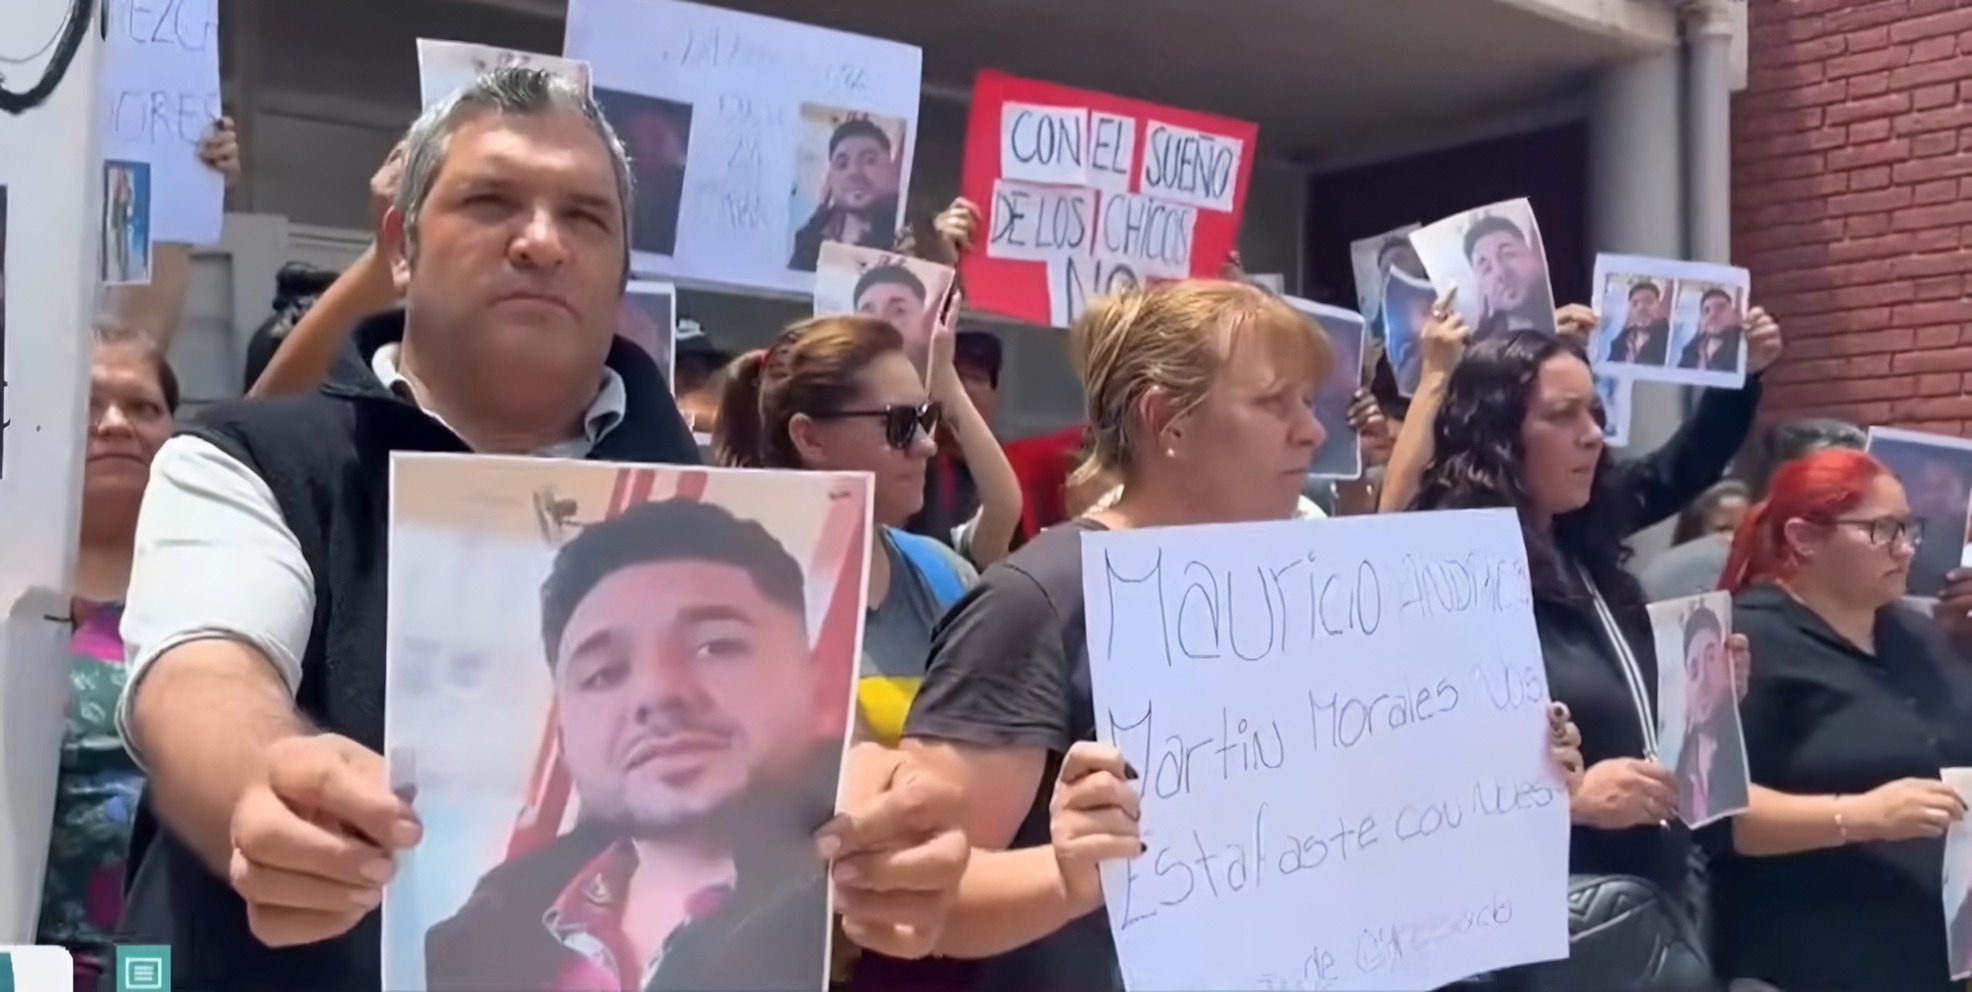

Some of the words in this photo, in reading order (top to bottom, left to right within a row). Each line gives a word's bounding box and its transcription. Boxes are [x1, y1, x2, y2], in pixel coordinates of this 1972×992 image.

[1011, 110, 1082, 168] CON
[1091, 117, 1128, 174] EL
[1145, 125, 1234, 200] SUEÑO
[990, 190, 1030, 246] DE
[1035, 195, 1086, 250] LOS
[1103, 193, 1190, 267] CHICOS
[1103, 546, 1381, 668] Mauricio
[1308, 675, 1460, 753] Morales
